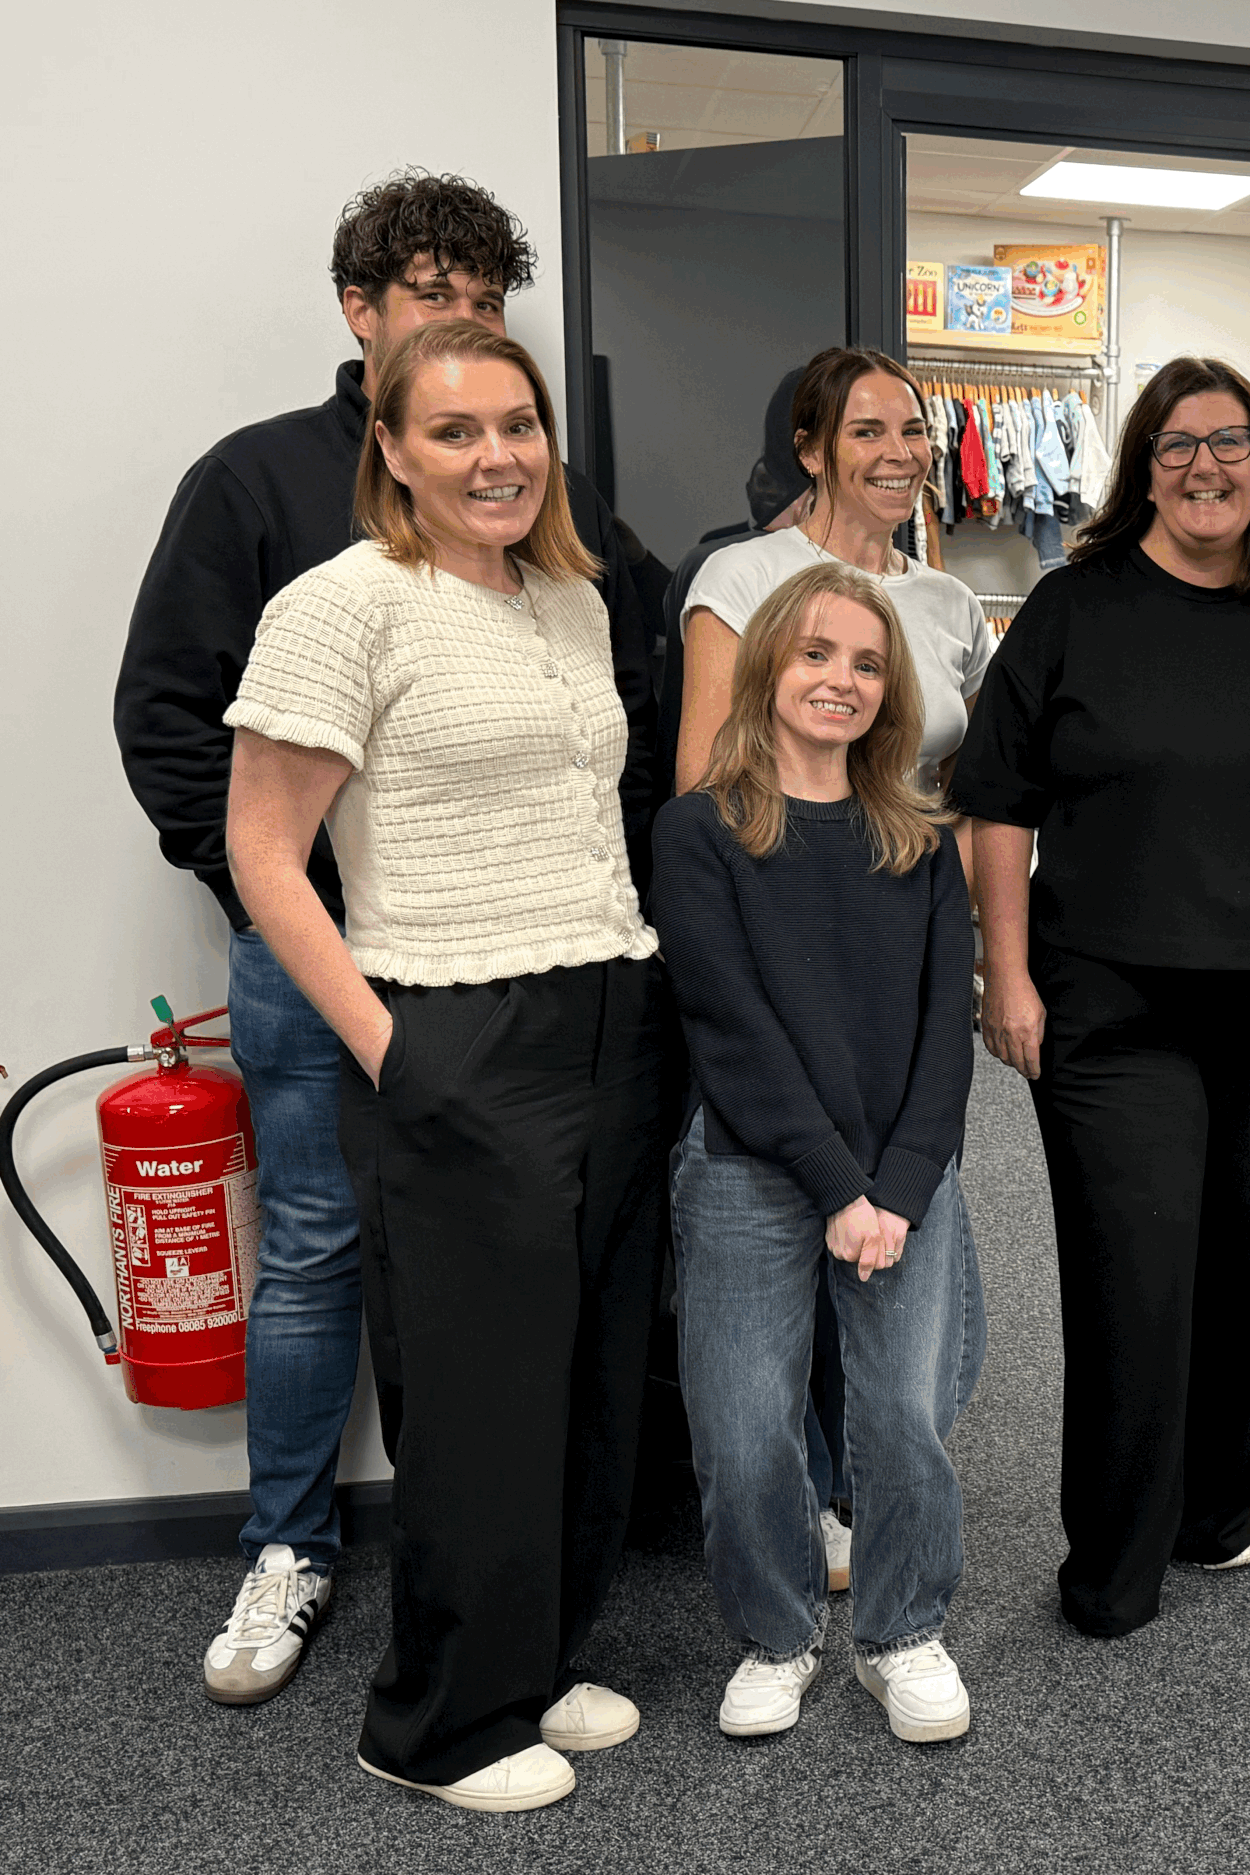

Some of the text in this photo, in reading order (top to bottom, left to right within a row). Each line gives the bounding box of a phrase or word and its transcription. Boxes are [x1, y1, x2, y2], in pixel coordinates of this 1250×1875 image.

[917, 266, 938, 276] Zoo
[957, 282, 1000, 292] UNICORN
[135, 1160, 204, 1177] Water
[133, 1187, 213, 1201] FIRE EXTINGUISHER
[169, 1206, 196, 1214] UPRIGHT
[181, 1210, 204, 1219] SAFETY
[178, 1229, 206, 1238] MINIMUM
[184, 1246, 208, 1255] LEVERS
[107, 1184, 134, 1330] NORTHANTS FIRE
[135, 1312, 238, 1334] Freephone 08085 920000
